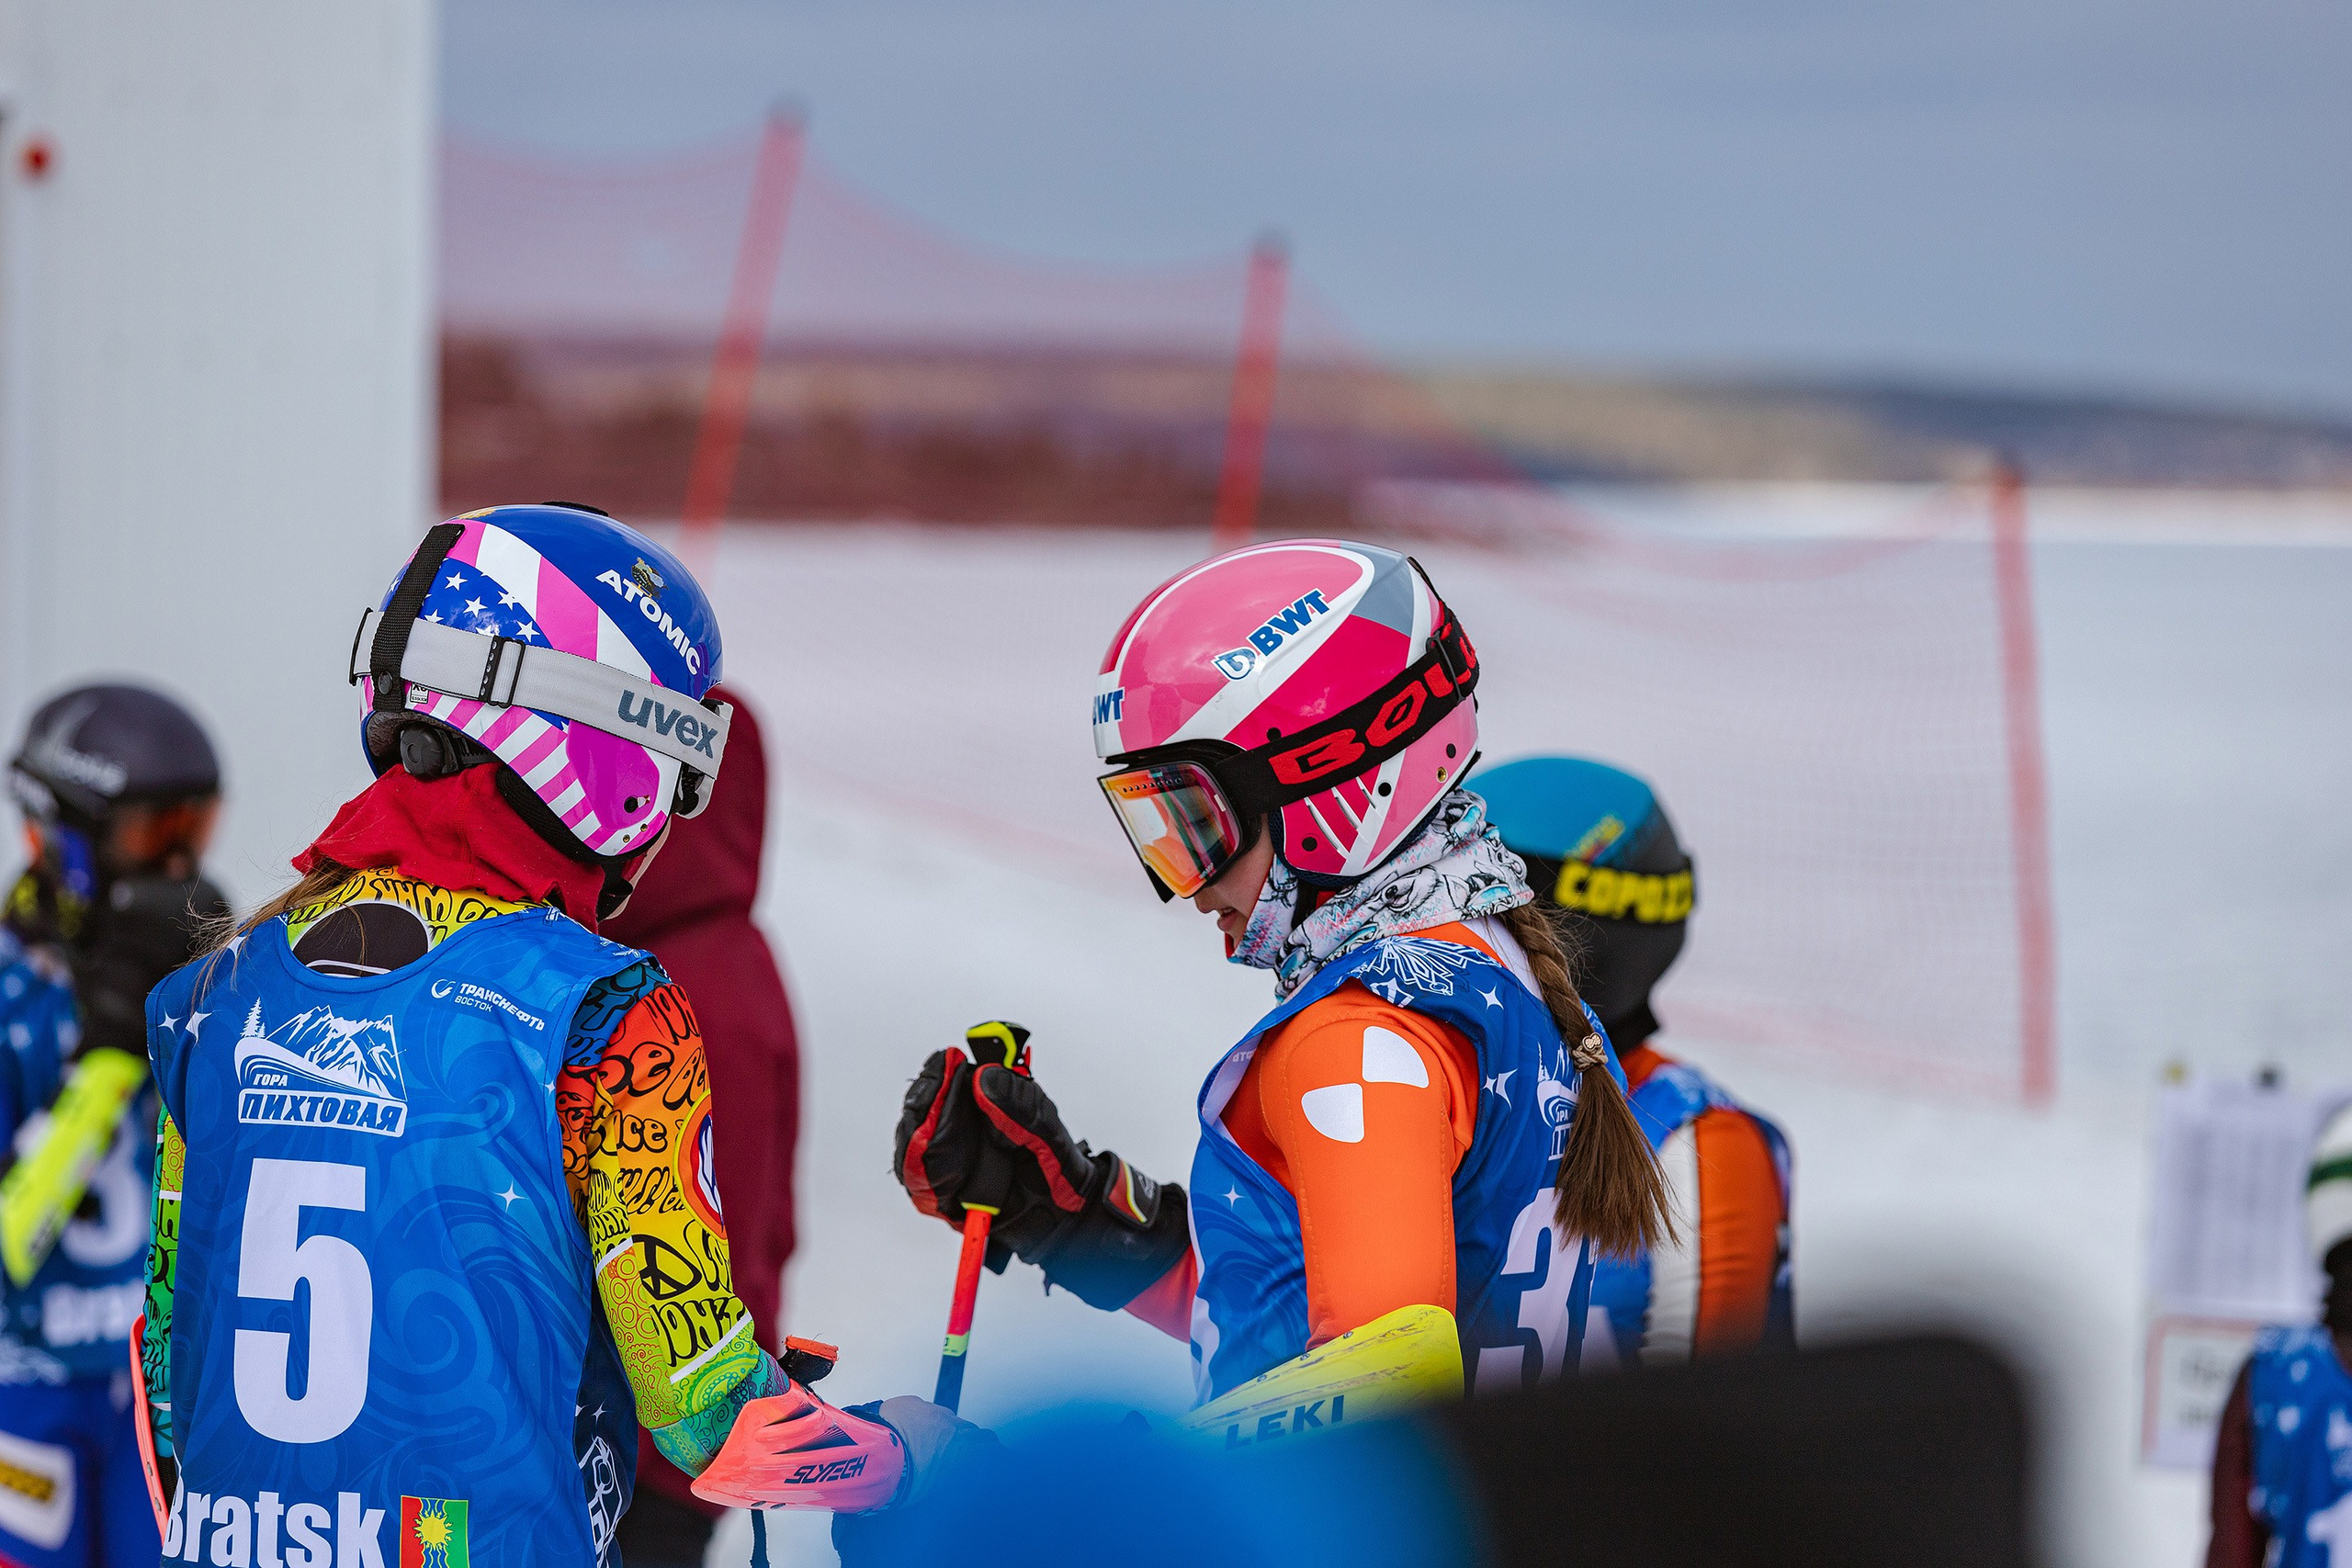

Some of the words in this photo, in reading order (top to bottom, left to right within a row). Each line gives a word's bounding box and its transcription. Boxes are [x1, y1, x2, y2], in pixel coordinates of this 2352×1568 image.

[595, 569, 701, 676] ATOMIC
[1248, 590, 1329, 657] BWT
[617, 689, 718, 760] uvex
[1093, 689, 1124, 726] WT
[455, 995, 493, 1012] ВОСТОК
[459, 983, 546, 1032] ТРАНСНЕФТЬ
[253, 1073, 288, 1087] ГОРА
[240, 1093, 403, 1134] ПИХТОВАЯ
[233, 1157, 374, 1444] 5
[1225, 1394, 1345, 1451] LEKI
[784, 1454, 868, 1484] SLYTECH
